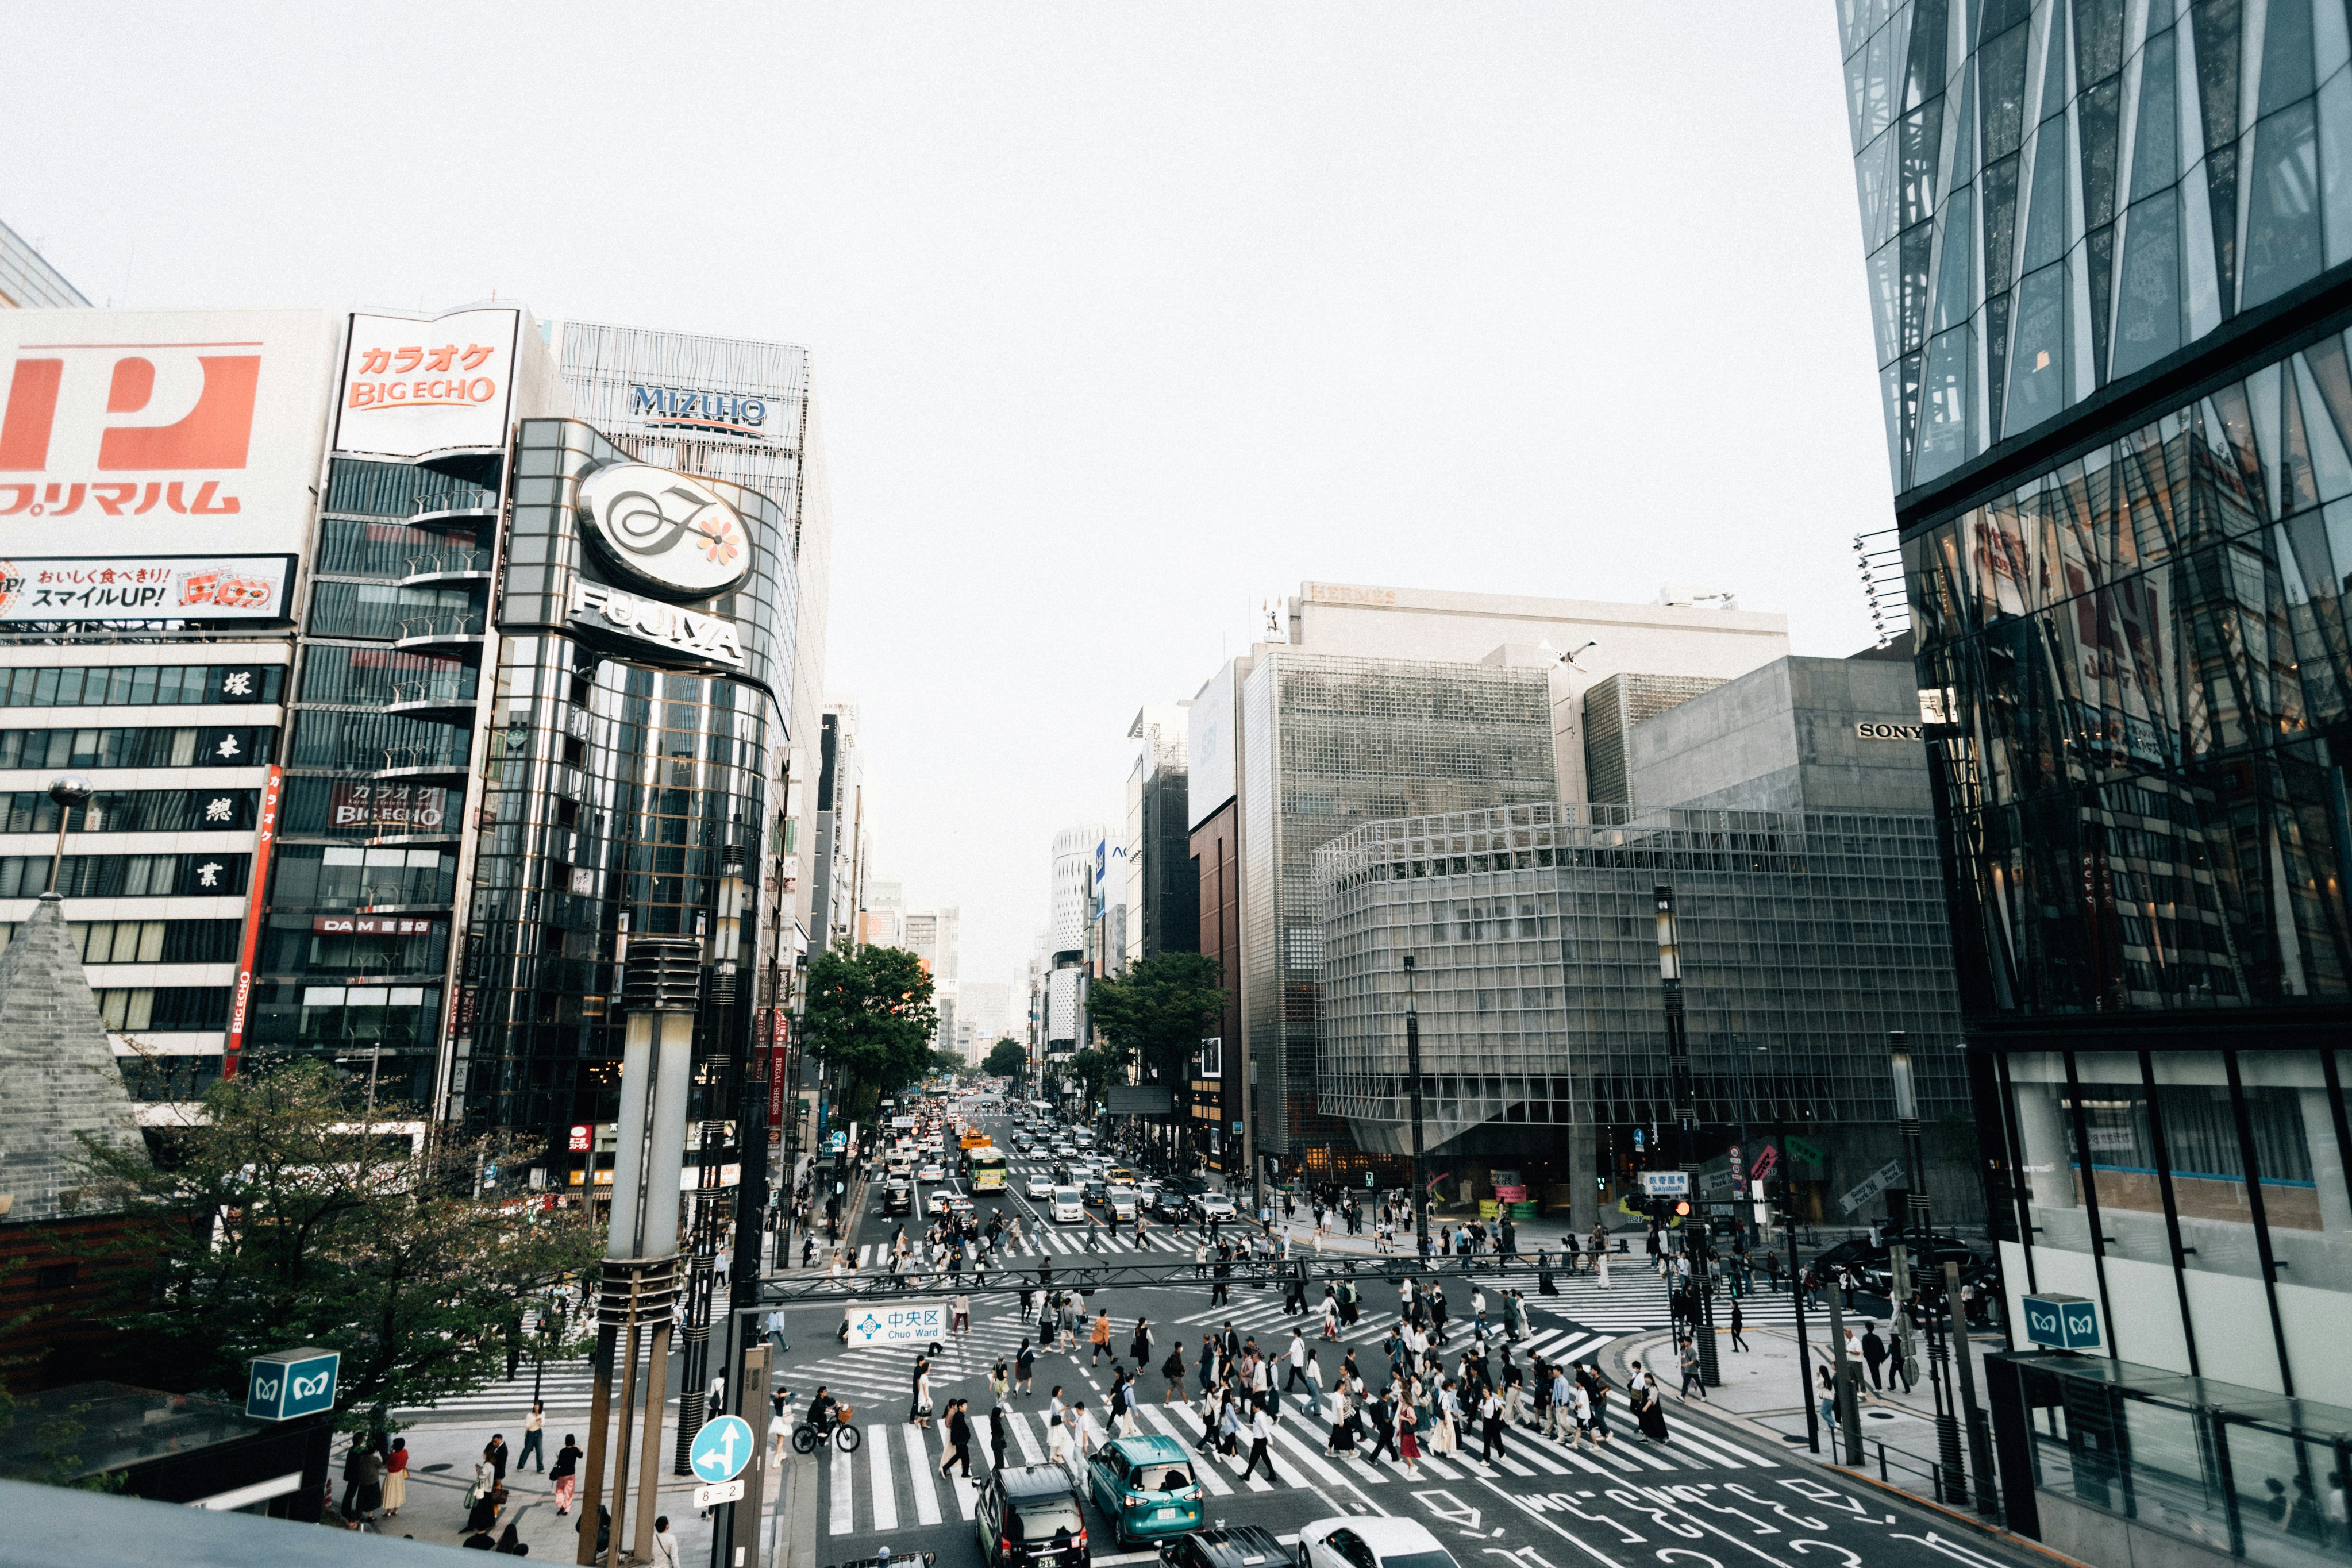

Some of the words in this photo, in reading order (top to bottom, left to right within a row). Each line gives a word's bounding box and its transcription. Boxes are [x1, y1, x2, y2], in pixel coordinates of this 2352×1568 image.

[357, 342, 495, 375] カラオケ
[348, 380, 406, 409] BIG
[412, 377, 495, 402] ECHO
[632, 387, 767, 421] MIZUHO
[0, 481, 241, 517] プリマハム
[32, 586, 166, 608] スマイルUP!
[570, 583, 744, 660] FUJIYA
[1860, 723, 1923, 739] SONY
[353, 785, 436, 799] カラオケ
[261, 774, 280, 842] カラオケ
[336, 806, 377, 824] BIG
[382, 807, 441, 826] ECHO
[324, 920, 374, 931] DAM
[382, 920, 429, 932] 直営店
[232, 1008, 242, 1033] BIG
[237, 971, 250, 1007] ECHO
[774, 1058, 782, 1085] REGAL
[1710, 1173, 1726, 1181] Sony
[1881, 1164, 1895, 1177] Sony
[1884, 1171, 1899, 1182] Park
[1502, 1174, 1512, 1185] 展
[1712, 1180, 1727, 1188] Park
[1851, 1185, 1865, 1199] Sony
[1854, 1192, 1869, 1205] Park
[1629, 1215, 1644, 1223] B2F
[888, 1311, 938, 1328] 中央区
[888, 1330, 910, 1339] Chuo
[915, 1328, 938, 1338] Ward
